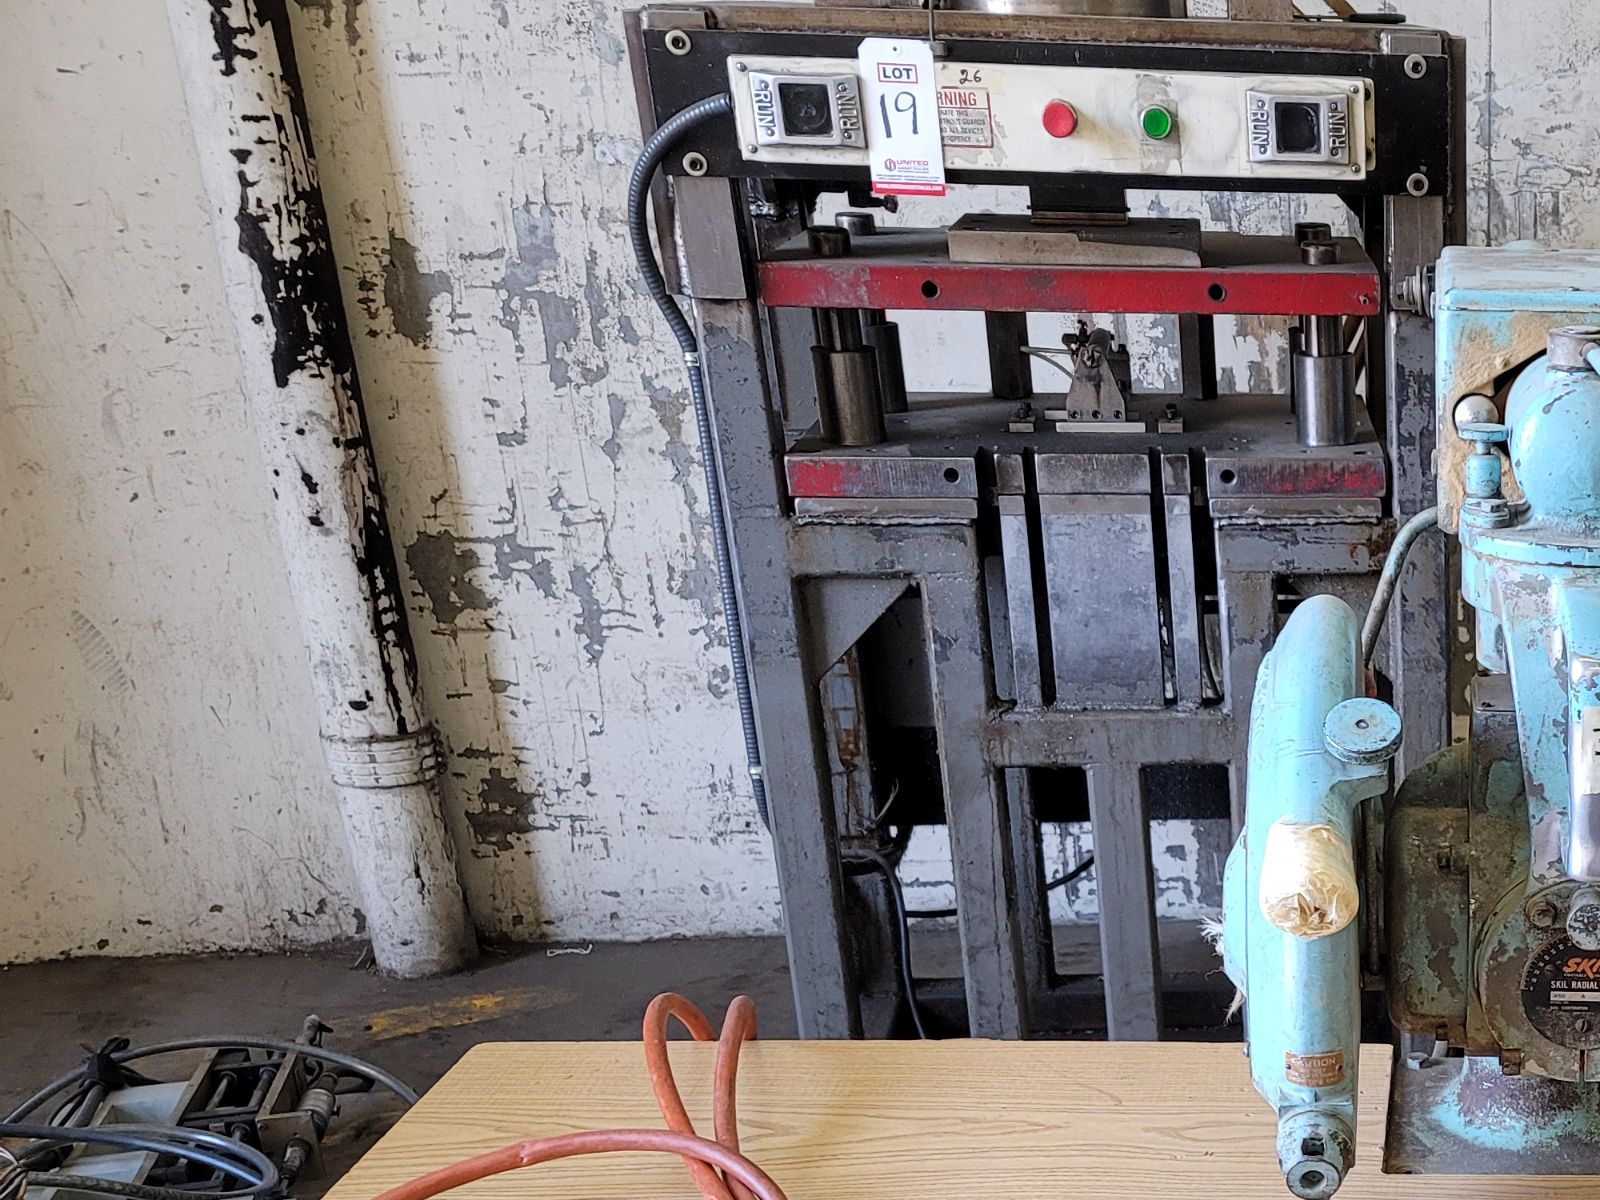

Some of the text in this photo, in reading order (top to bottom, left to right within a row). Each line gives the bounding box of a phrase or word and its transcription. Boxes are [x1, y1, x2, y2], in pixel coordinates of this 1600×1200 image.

[882, 67, 912, 79] LOT
[959, 69, 982, 84] 26
[754, 89, 776, 129] RUN
[836, 93, 860, 130] RUN
[879, 91, 918, 138] 19
[1250, 109, 1271, 146] RUN
[1328, 111, 1346, 148] RUN
[1550, 980, 1568, 989] SKIL
[1571, 981, 1599, 989] RADIAL
[1291, 1057, 1336, 1068] CAUTION
